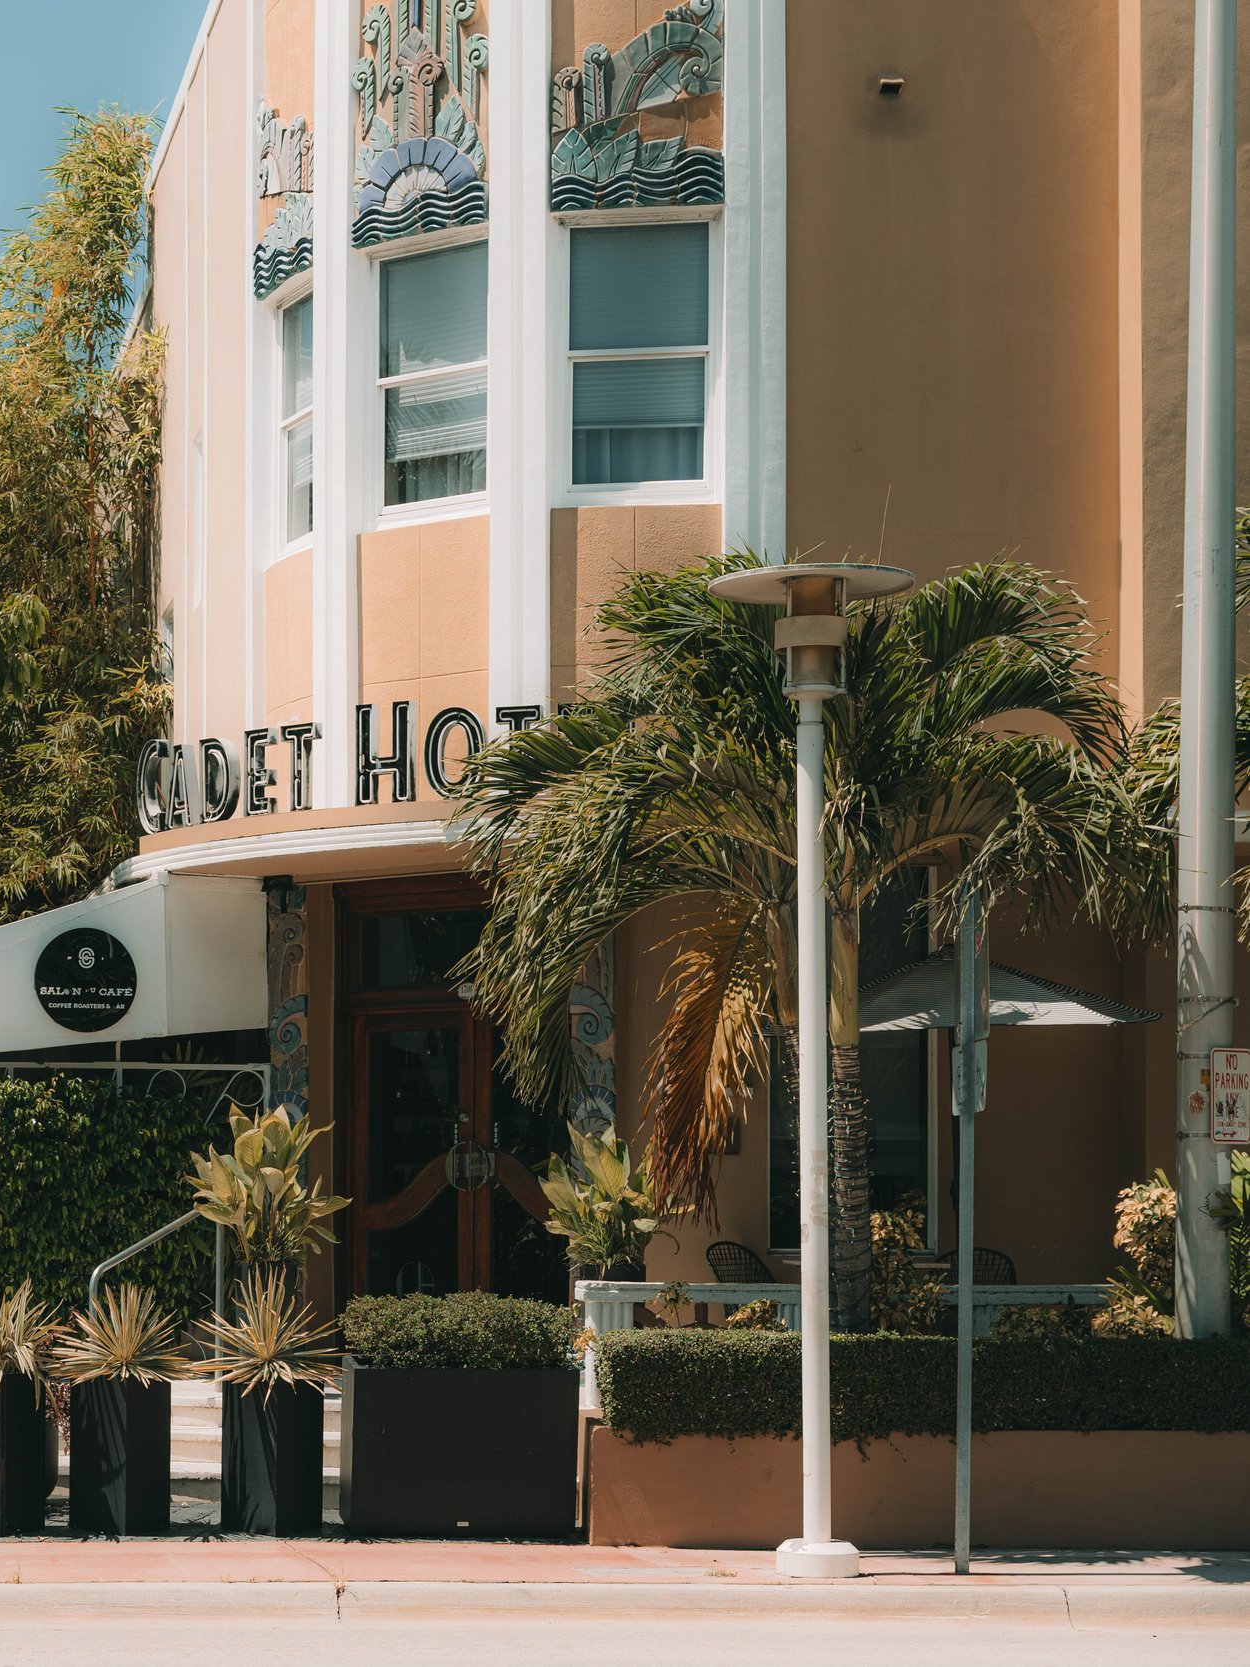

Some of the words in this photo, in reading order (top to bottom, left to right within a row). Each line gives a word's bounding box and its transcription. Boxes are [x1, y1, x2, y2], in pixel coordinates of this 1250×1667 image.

[137, 722, 322, 835] CADET
[355, 700, 600, 806] HOT
[99, 986, 133, 996] CAFÉ
[1225, 1054, 1238, 1070] NO
[1215, 1073, 1249, 1090] PARKING
[1225, 1093, 1239, 1101] ANY
